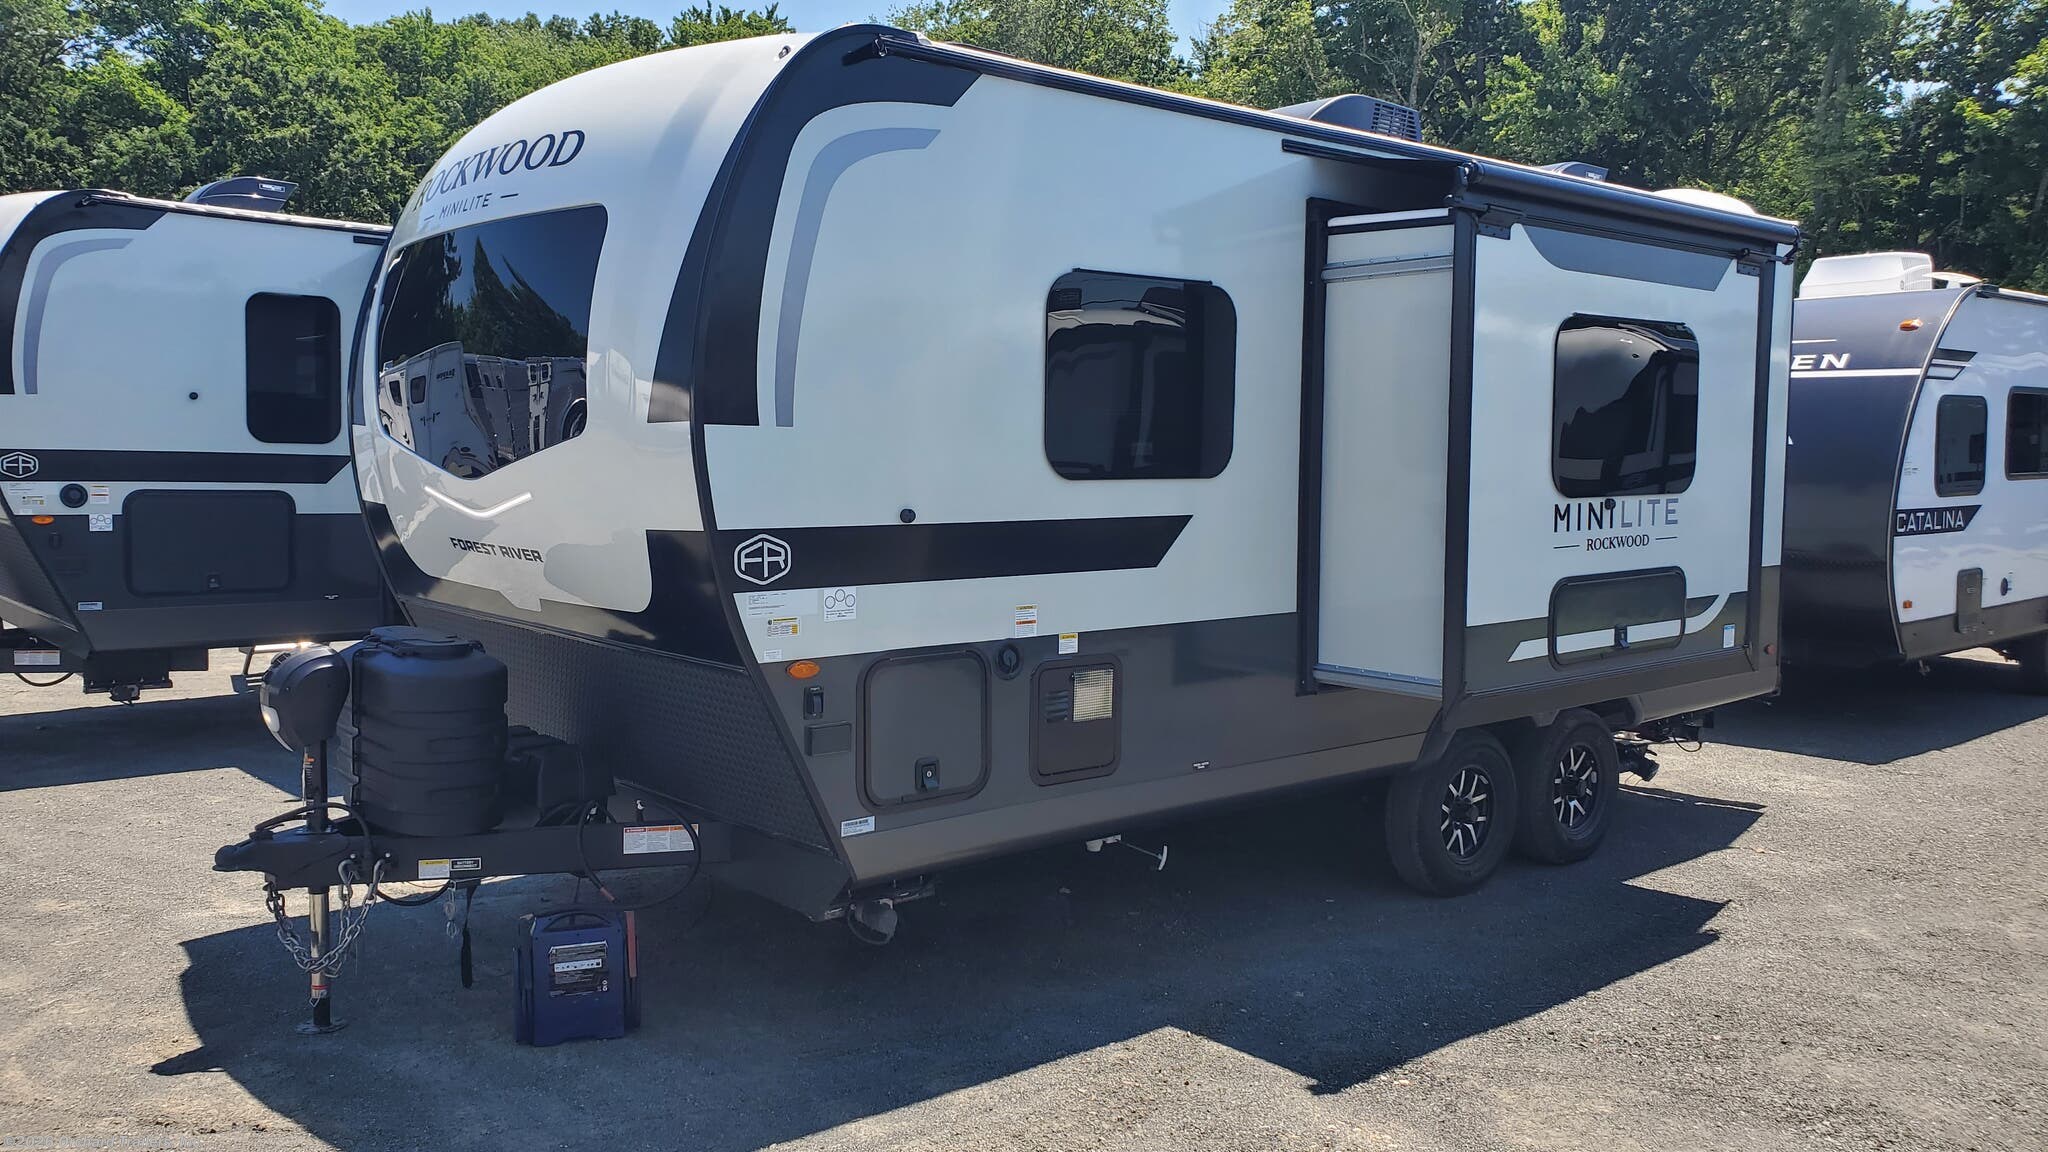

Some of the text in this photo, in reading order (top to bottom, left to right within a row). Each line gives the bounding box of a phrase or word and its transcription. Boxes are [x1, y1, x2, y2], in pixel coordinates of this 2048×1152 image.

[412, 129, 586, 212] ROCKWOOD
[438, 193, 493, 220] MINILITE
[1553, 498, 1679, 533] MINILITE
[1896, 510, 1965, 533] CATALINA
[449, 536, 544, 563] FOREST RIVER
[1586, 534, 1650, 551] ROCKWOOD
